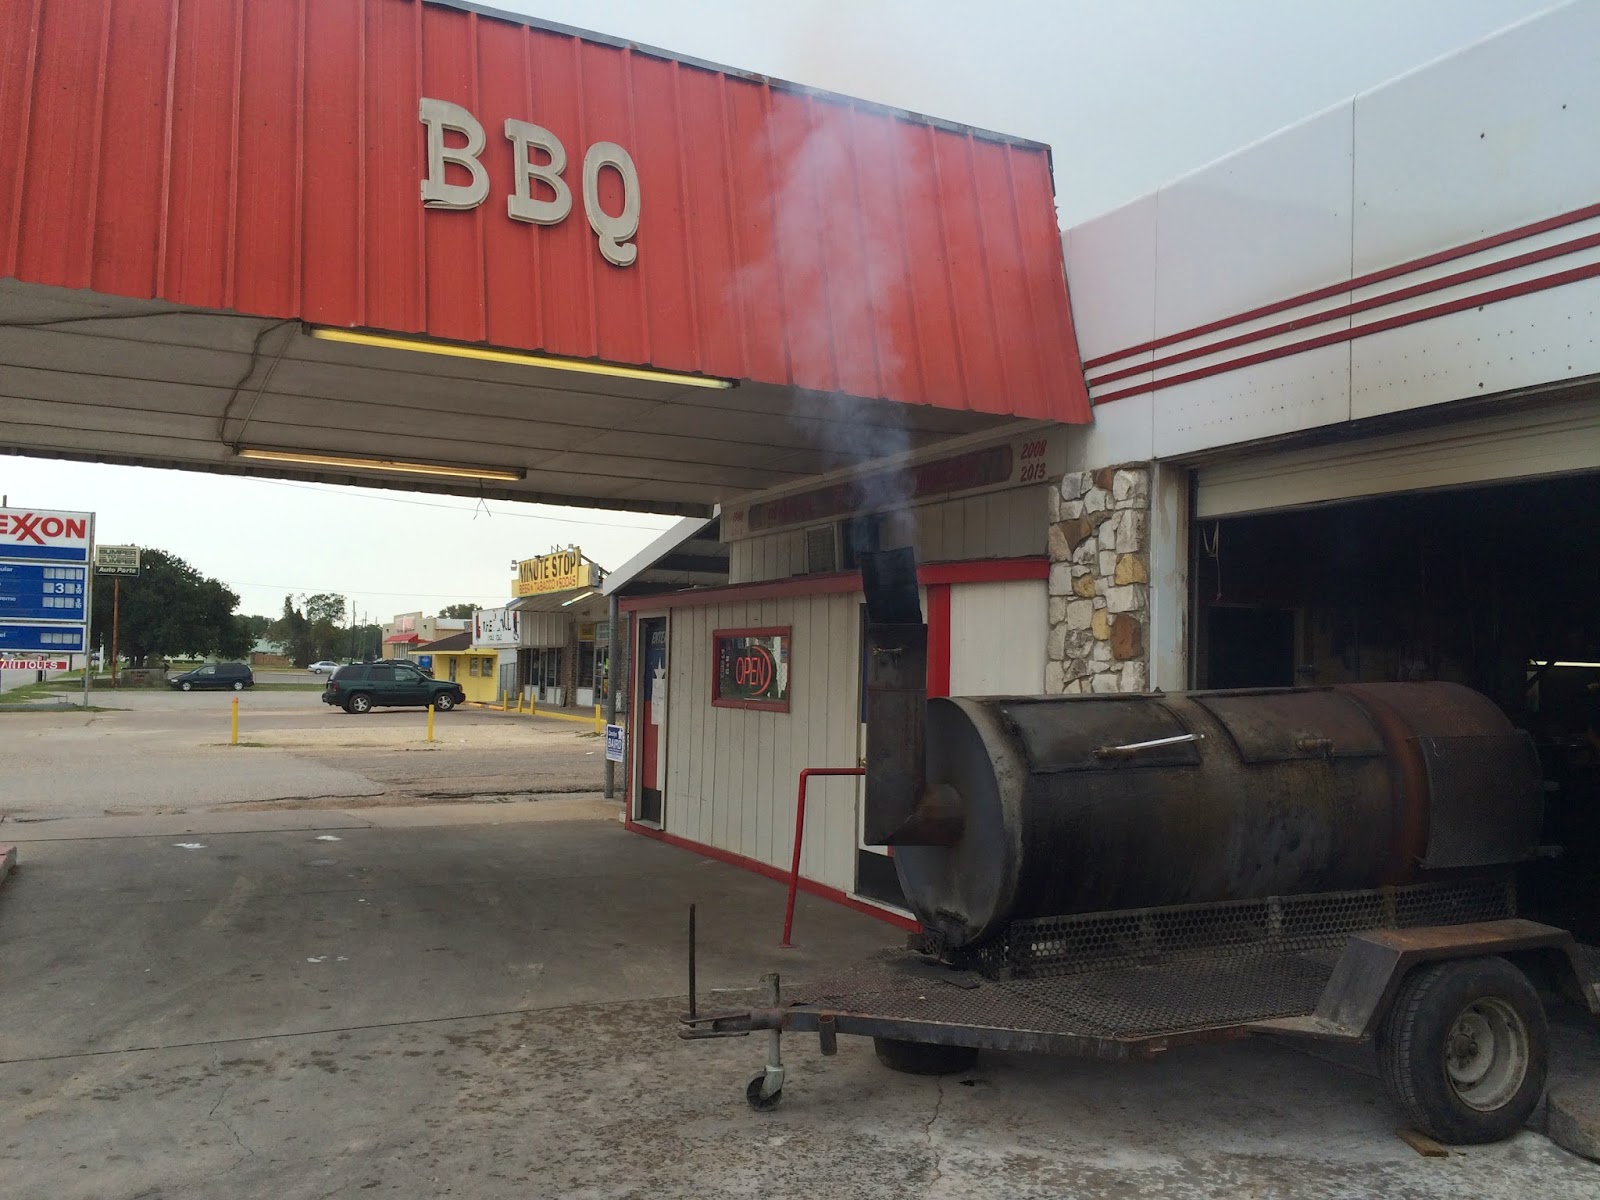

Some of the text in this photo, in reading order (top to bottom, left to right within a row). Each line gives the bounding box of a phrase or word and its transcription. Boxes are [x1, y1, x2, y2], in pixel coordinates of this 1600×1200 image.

[419, 97, 641, 266] BBQ
[1020, 462, 1046, 482] 2013
[519, 552, 576, 583] MINUTE STOP
[55, 582, 65, 594] 3
[519, 583, 530, 595] BEER
[559, 575, 576, 588] SODAS
[735, 656, 765, 686] OPEN
